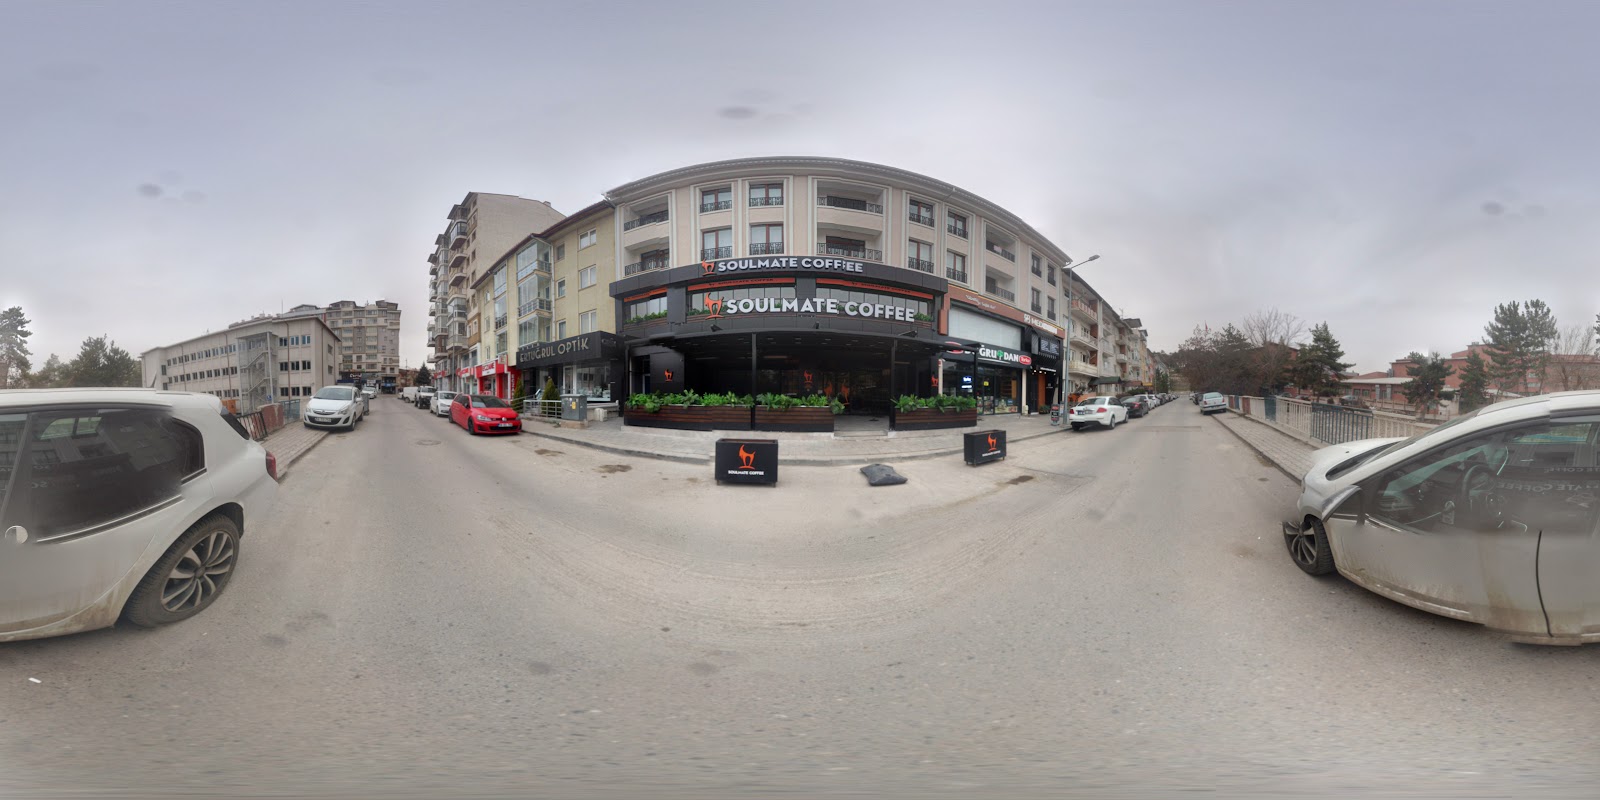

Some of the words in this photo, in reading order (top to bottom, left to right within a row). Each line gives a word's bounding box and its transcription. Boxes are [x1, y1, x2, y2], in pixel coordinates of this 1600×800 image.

[717, 257, 798, 272] SOULMATE
[726, 297, 840, 314] SOULMATE
[844, 301, 915, 322] COFFEE
[520, 345, 556, 363] ERTUĞRUL
[557, 337, 589, 354] OPTİK
[1003, 351, 1019, 362] DAN
